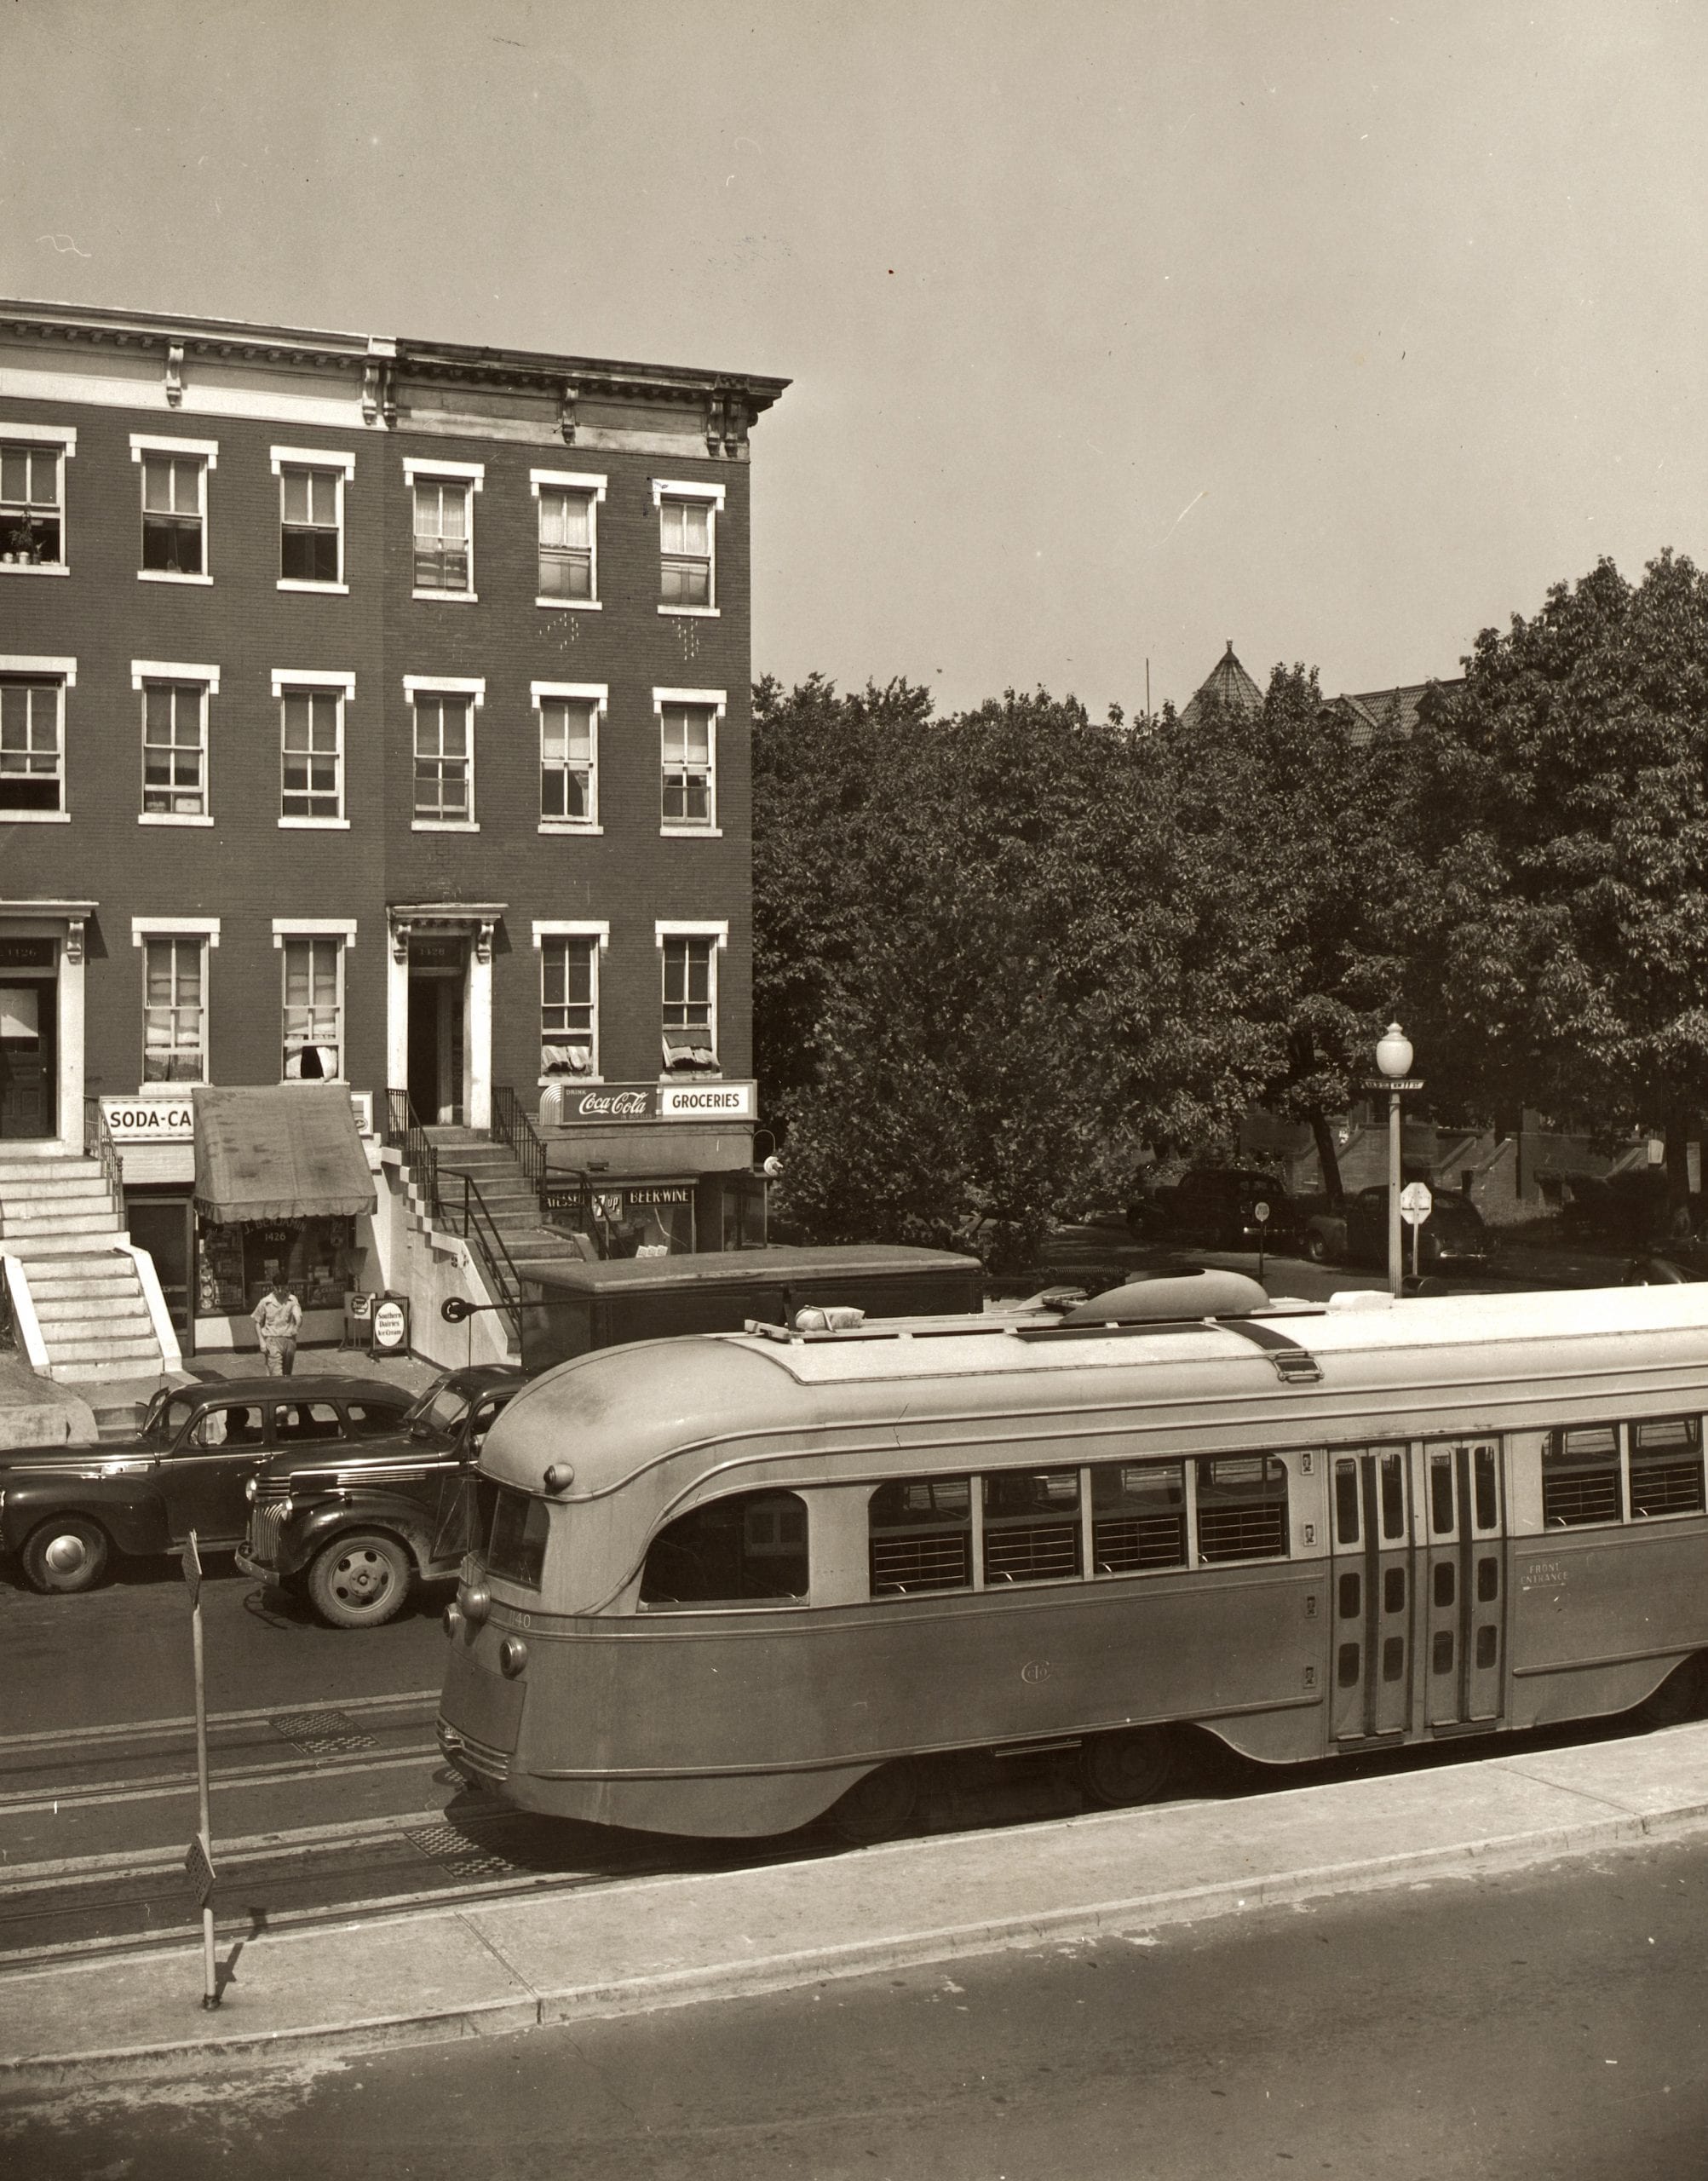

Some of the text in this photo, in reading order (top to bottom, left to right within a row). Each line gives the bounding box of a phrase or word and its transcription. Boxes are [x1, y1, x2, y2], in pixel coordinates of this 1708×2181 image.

[578, 1091, 649, 1115] Coca-Cola
[672, 1093, 739, 1108] GROCERIES
[110, 1110, 192, 1128] SODA-CA
[595, 1194, 606, 1217] 7
[256, 1217, 307, 1232] BENJAMIN
[265, 1232, 286, 1241] 1426
[1529, 1562, 1560, 1574] FRONT
[1521, 1571, 1567, 1585] ENTRANCE
